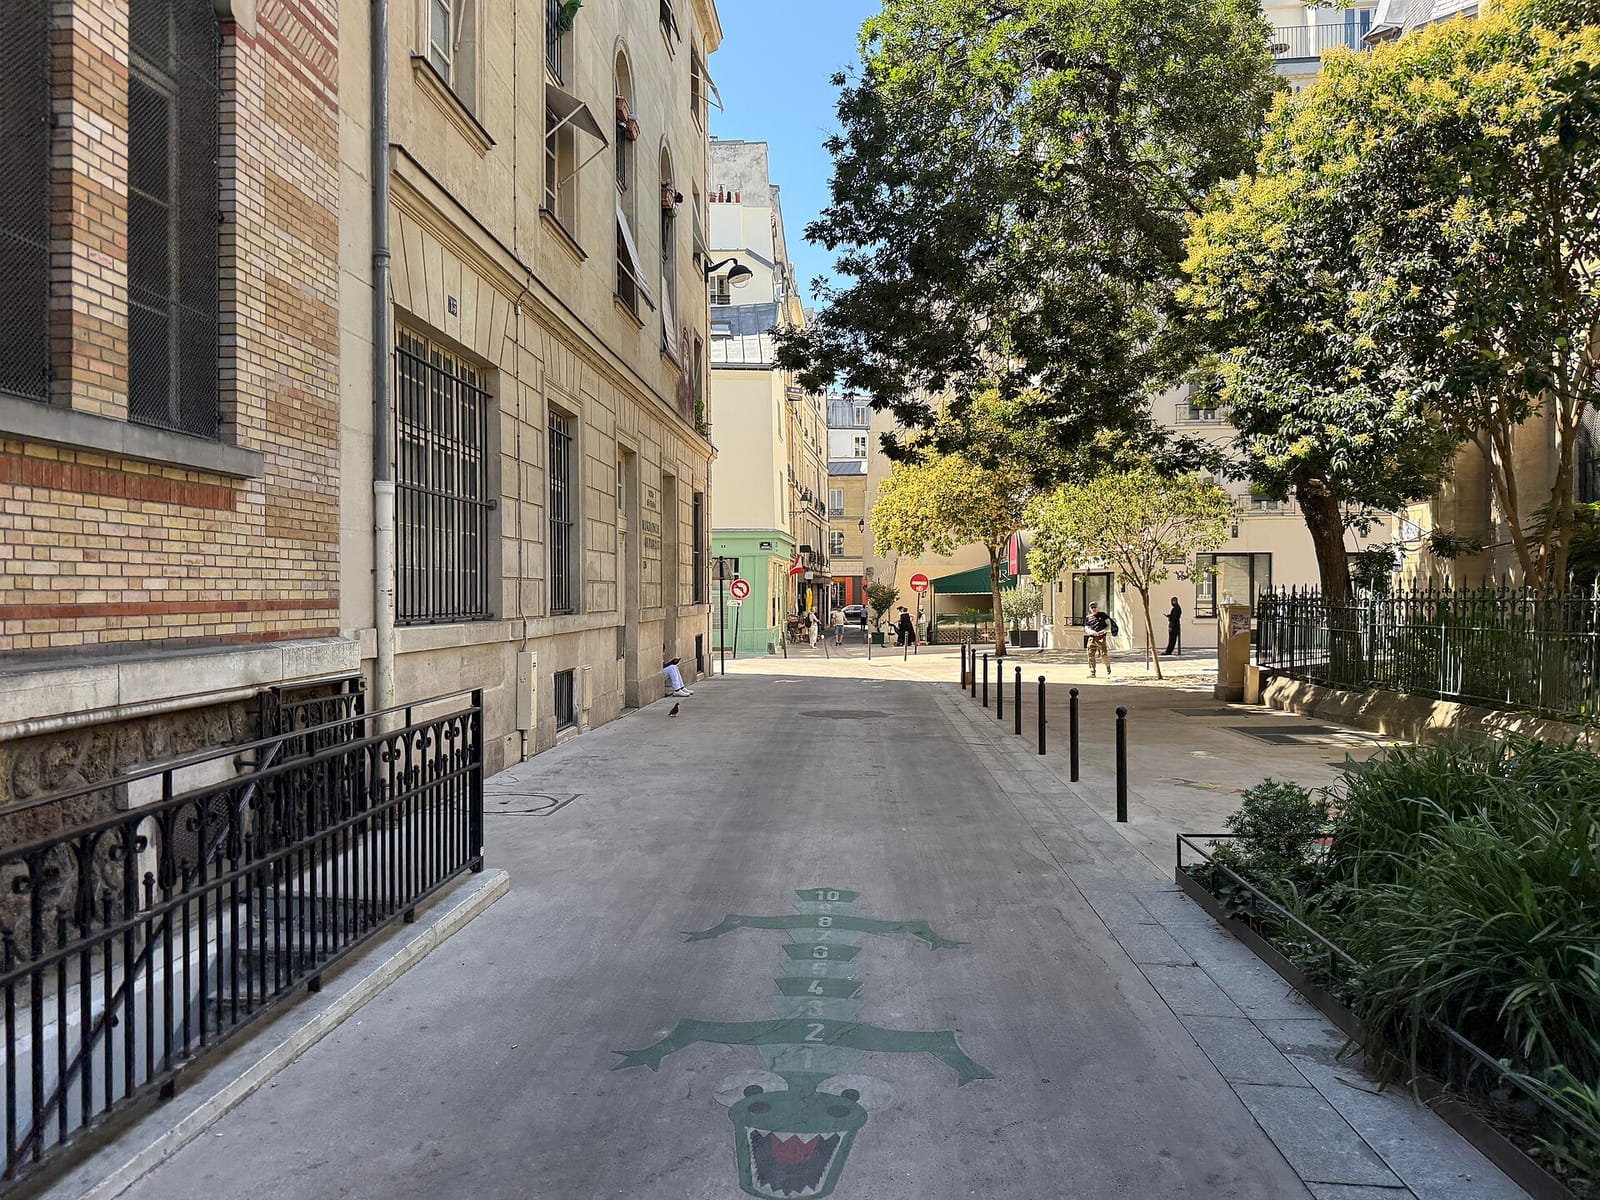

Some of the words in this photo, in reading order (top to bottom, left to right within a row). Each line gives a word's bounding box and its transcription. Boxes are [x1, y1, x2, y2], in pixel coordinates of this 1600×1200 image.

[816, 890, 840, 900] 10
[818, 916, 833, 928] 8
[812, 945, 829, 959] 6
[811, 962, 827, 975] 5
[807, 979, 824, 995] 4
[805, 1023, 825, 1041] 2
